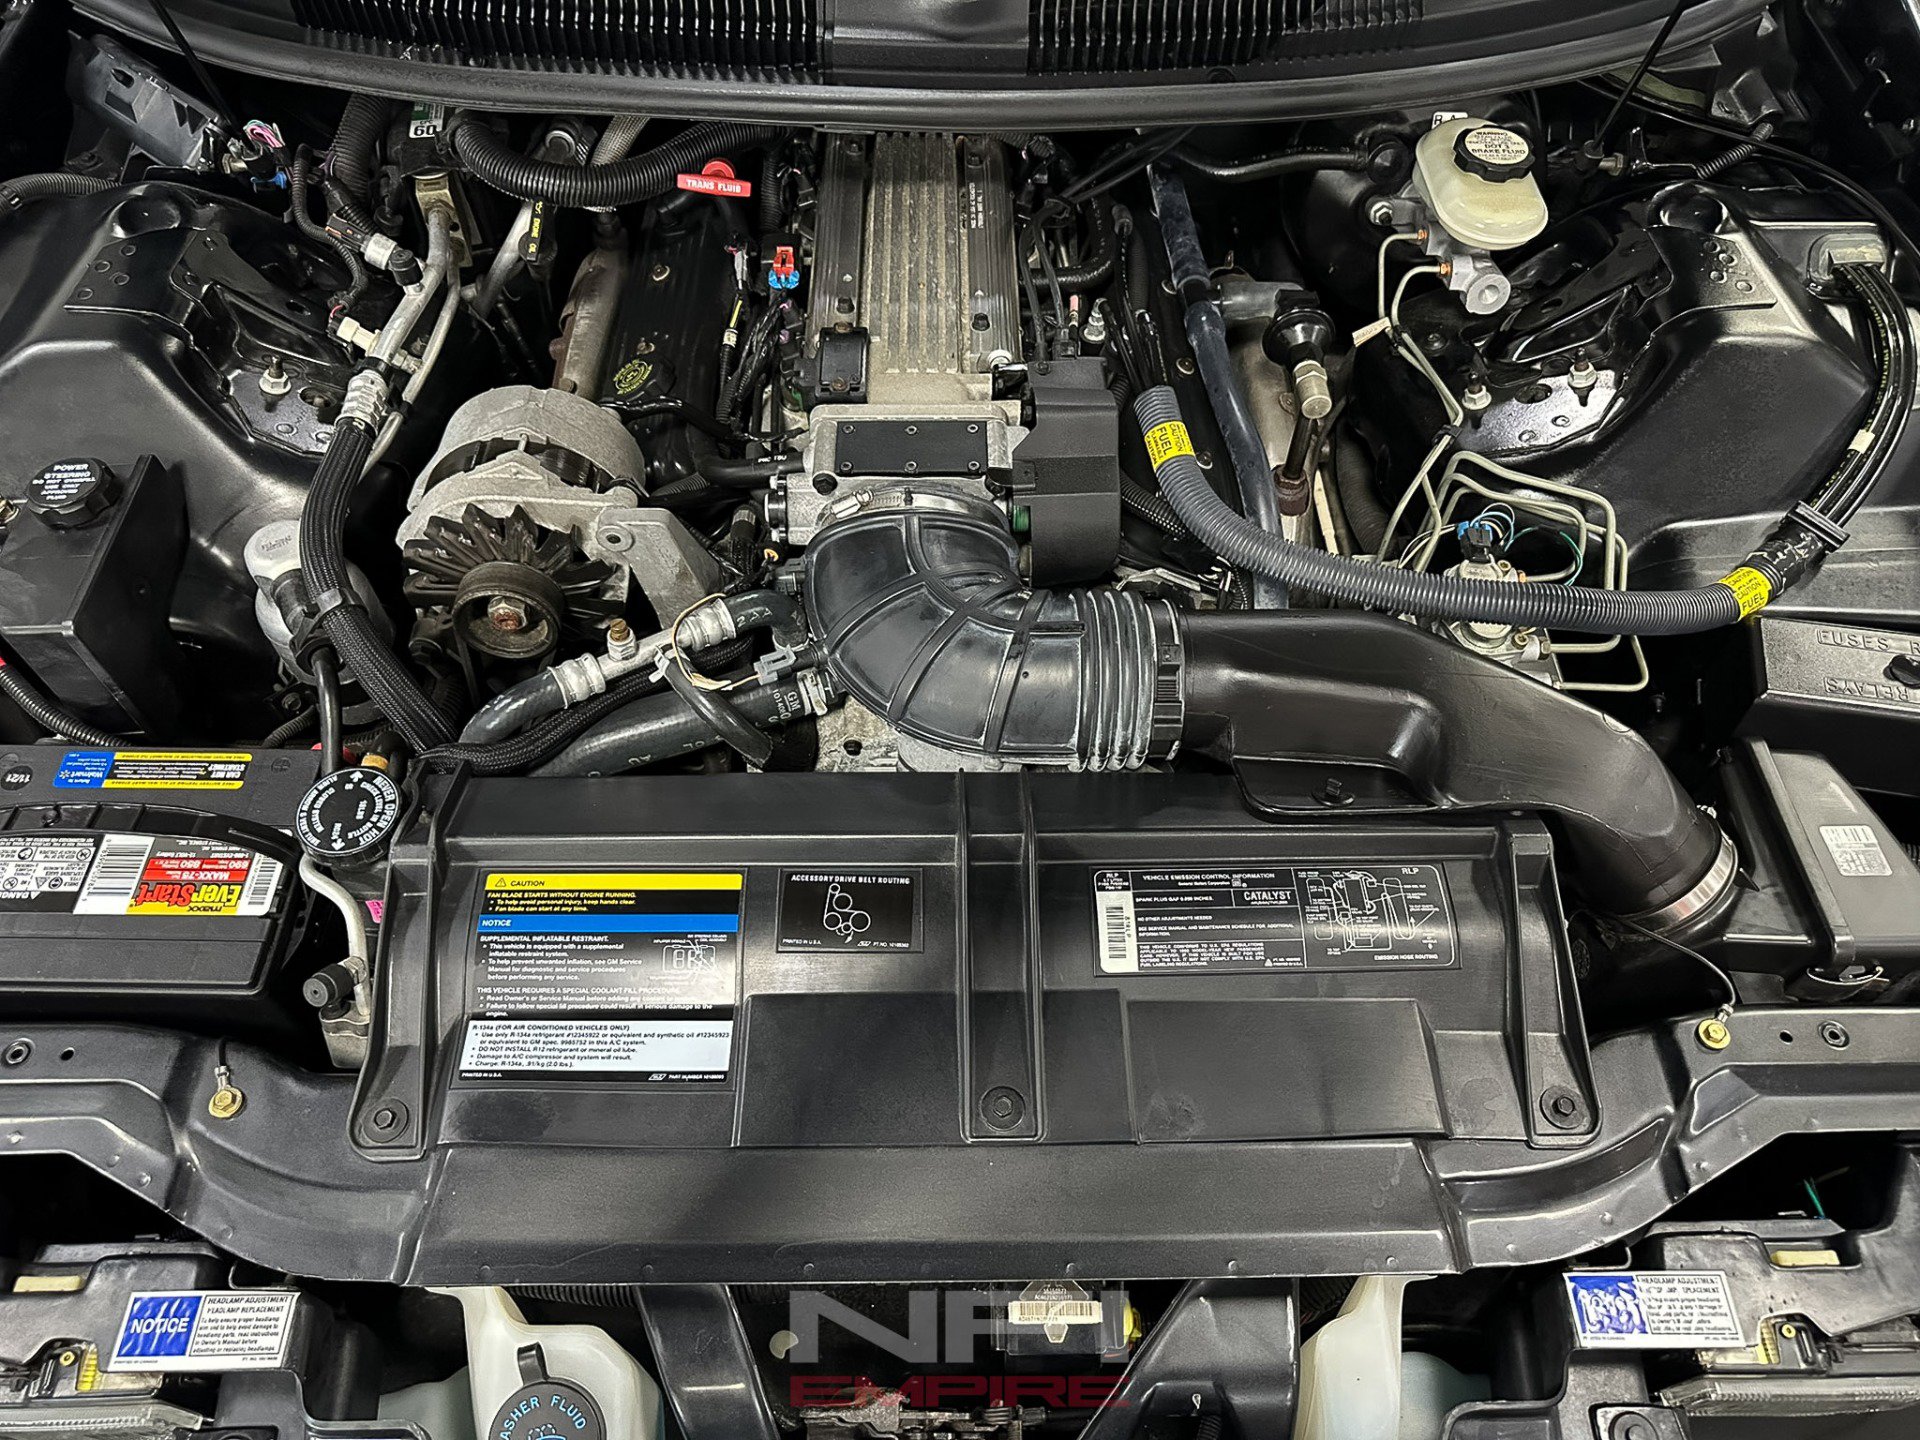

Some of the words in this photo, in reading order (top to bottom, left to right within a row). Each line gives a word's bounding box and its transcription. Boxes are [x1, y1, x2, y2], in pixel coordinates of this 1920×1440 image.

[686, 179, 715, 190] TRANS
[718, 182, 741, 193] FLUID
[1157, 426, 1172, 455] FUEL
[1169, 423, 1183, 452] CAUTION
[44, 471, 91, 479] STEERING
[1736, 581, 1761, 600] CAUTION
[1742, 592, 1764, 611] FUEL
[1819, 630, 1890, 650] FUSES
[1826, 678, 1909, 701] RELAYS
[788, 691, 801, 711] GM
[5, 774, 31, 783] 11/21
[69, 770, 103, 779] Walmart
[373, 776, 396, 801] NEVER
[376, 803, 396, 828] OPEN
[347, 821, 373, 839] BOTTLE
[358, 828, 379, 846] HOT
[180, 860, 201, 868] 850
[229, 860, 249, 869] 690
[791, 875, 834, 883] ACCESSORY
[834, 875, 856, 883] DRIVE
[877, 876, 910, 885] ROUTING
[0, 891, 29, 899] DANG
[136, 883, 242, 907] EverStart
[1244, 891, 1291, 901] CATALYST
[130, 1318, 190, 1334] NOTICE
[500, 1396, 540, 1440] ASHER
[550, 1395, 587, 1429] FLUID
